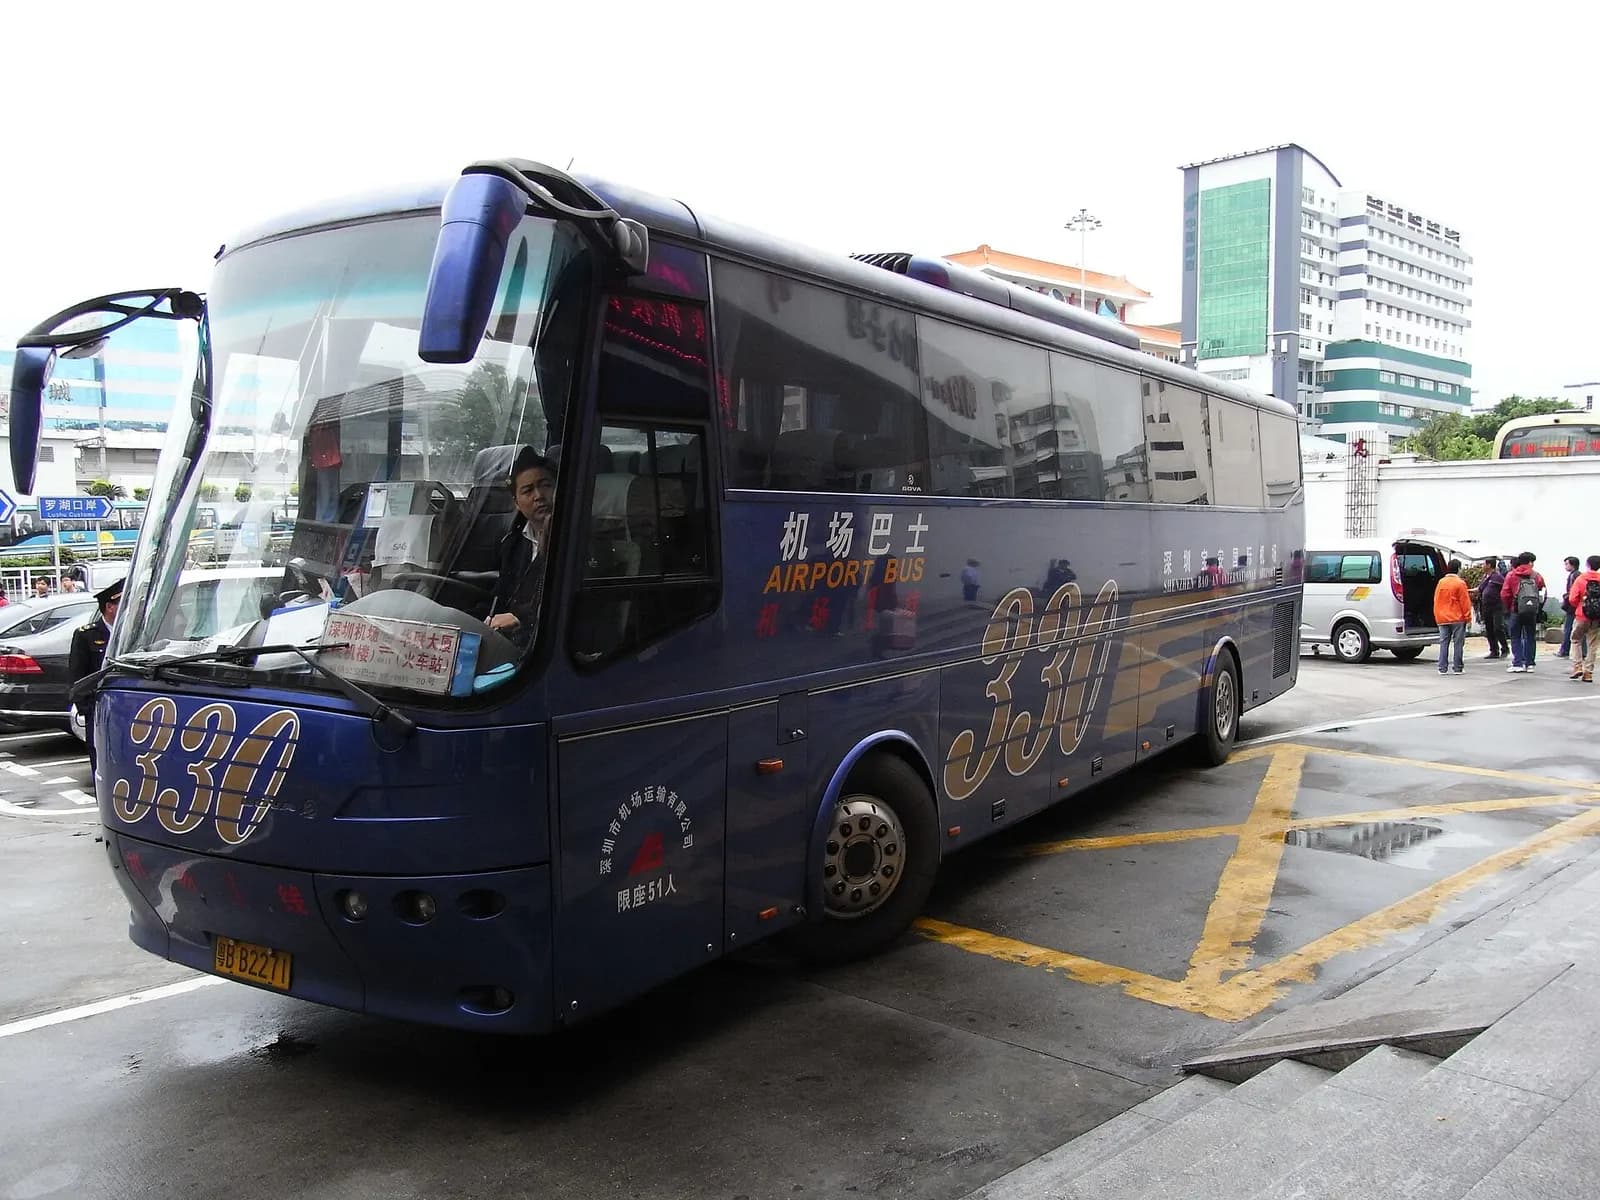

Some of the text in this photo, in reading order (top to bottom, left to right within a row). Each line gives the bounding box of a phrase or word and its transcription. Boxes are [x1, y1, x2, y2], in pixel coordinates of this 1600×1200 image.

[45, 499, 97, 511] 罗湖口岸
[780, 511, 929, 561] 机场巴士
[763, 557, 925, 593] AIRPORT BUS
[328, 620, 379, 643] 深圳机场
[943, 579, 1119, 800] 330
[112, 697, 300, 845] 330
[599, 785, 694, 875] 深圳市机场运输有限公司
[617, 873, 677, 913] 限座51人
